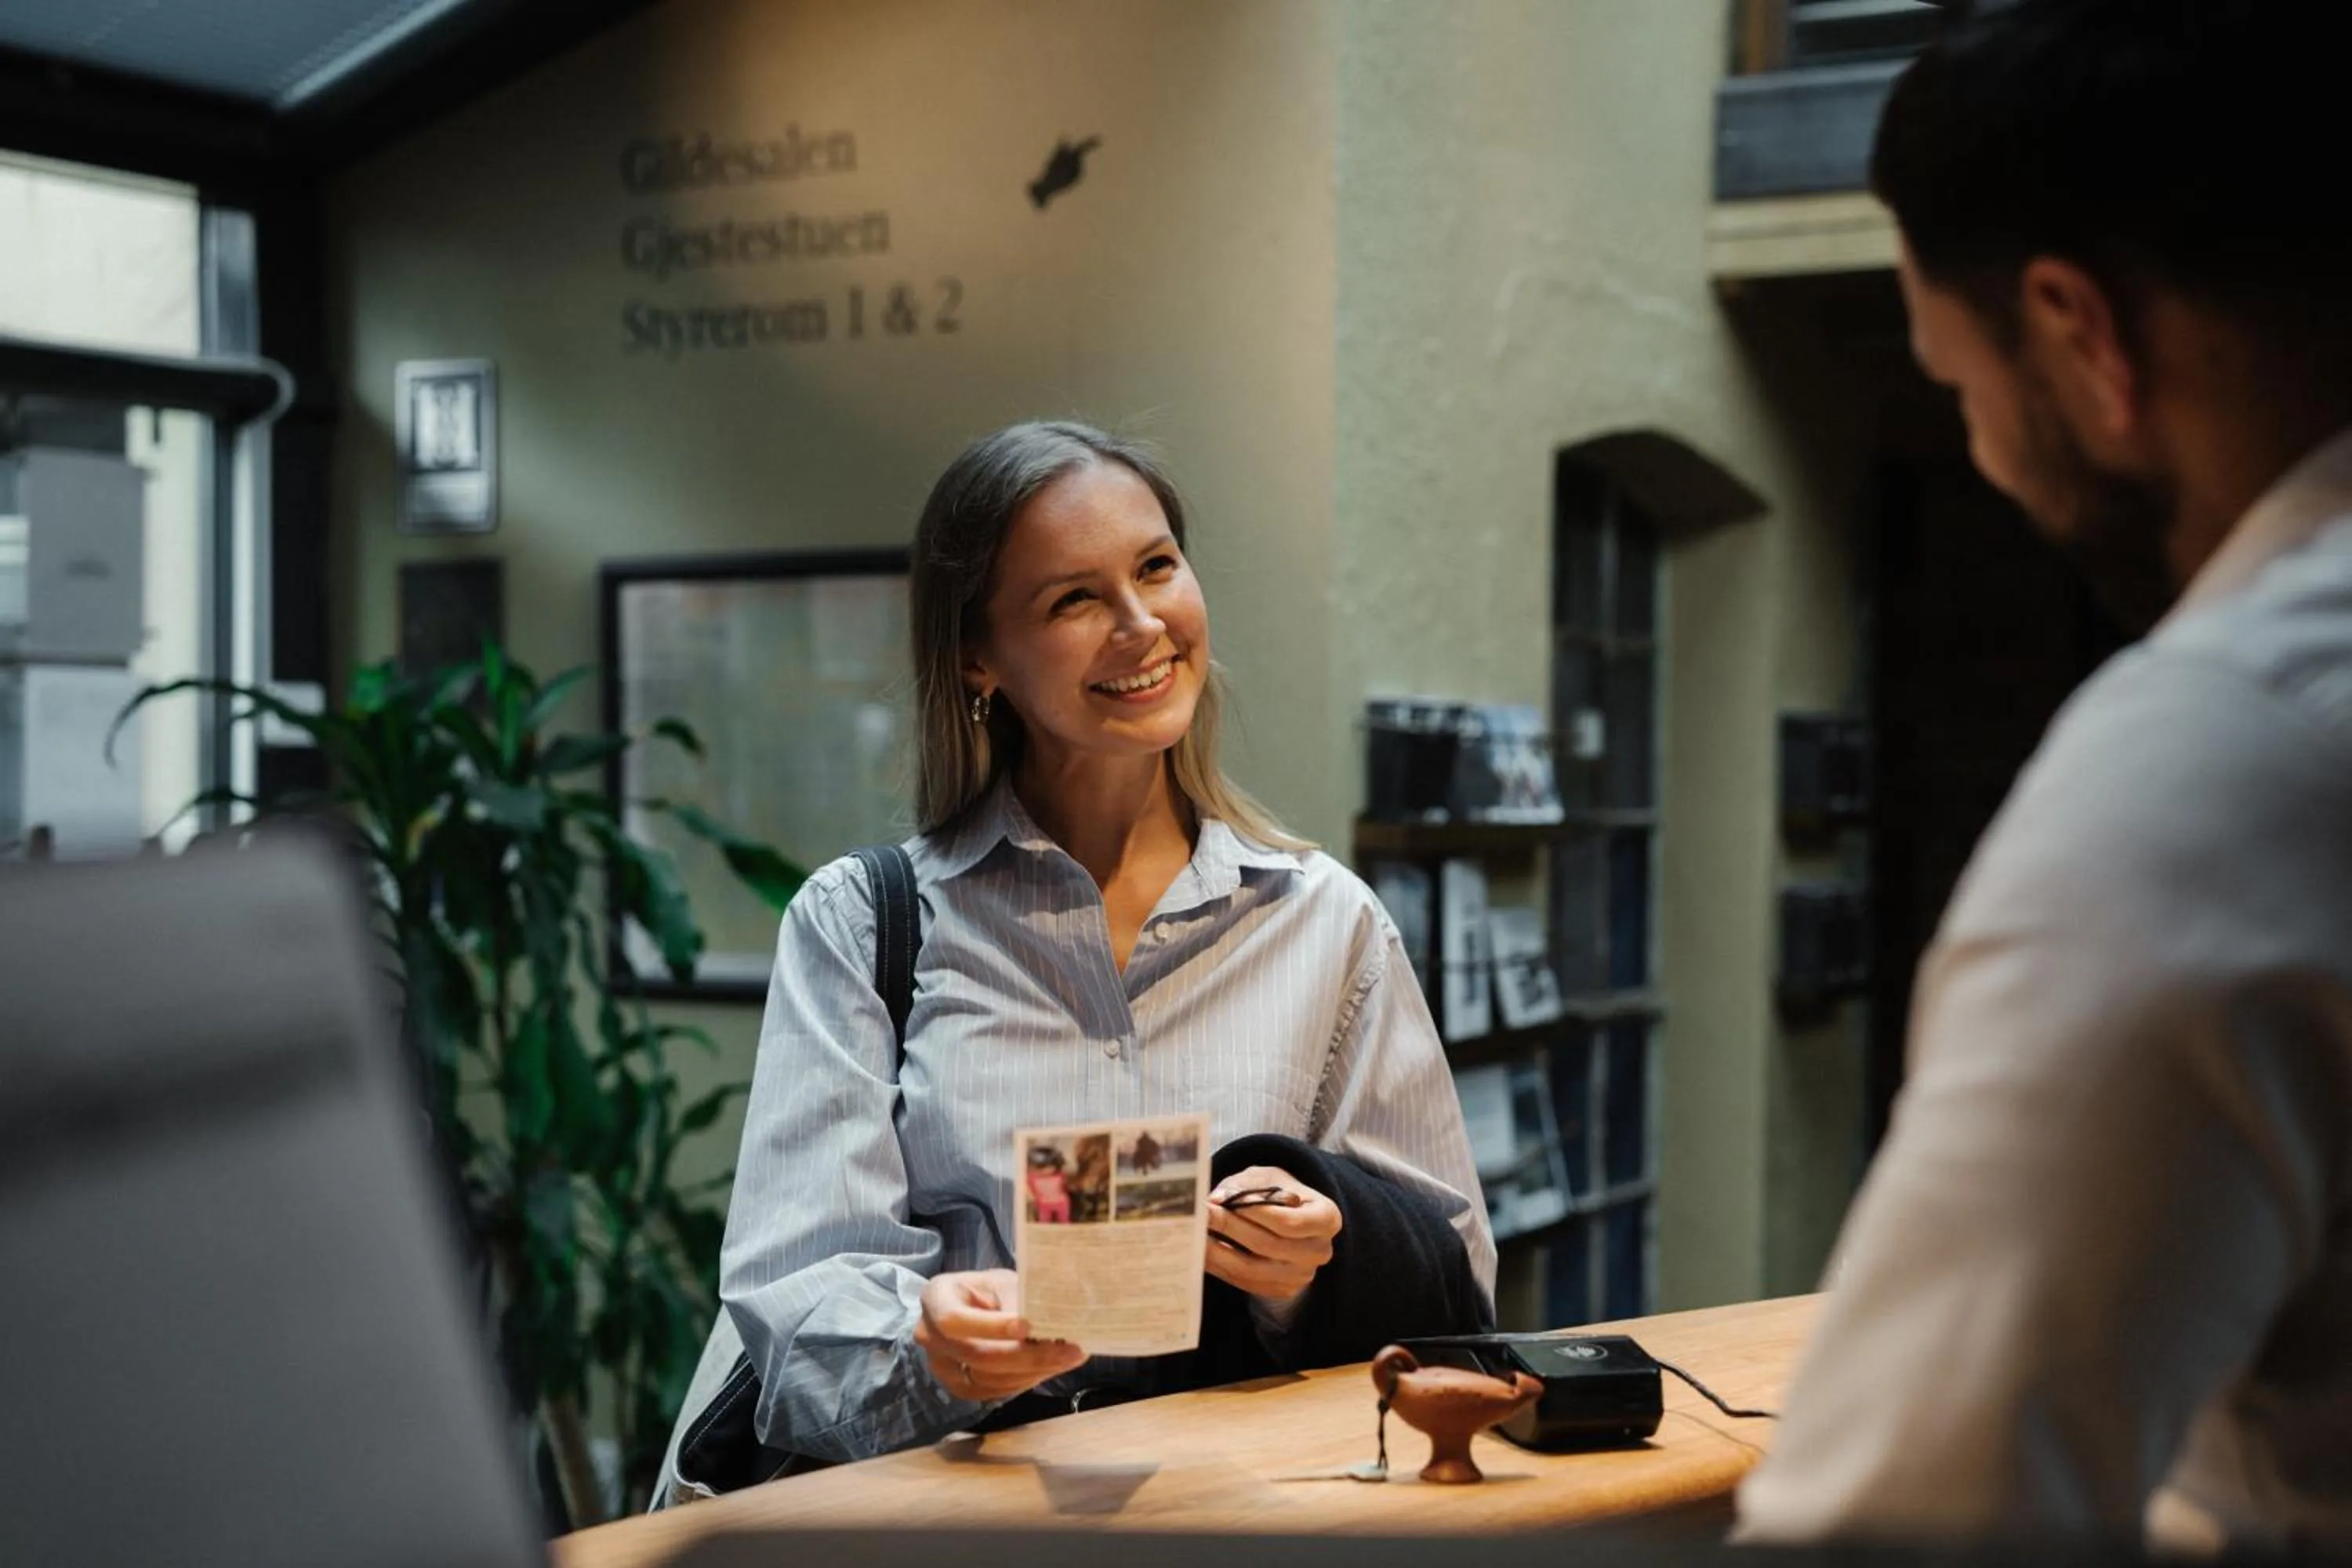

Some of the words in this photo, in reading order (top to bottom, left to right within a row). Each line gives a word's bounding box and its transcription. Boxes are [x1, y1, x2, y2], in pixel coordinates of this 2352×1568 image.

[619, 122, 858, 194] Gildesalen
[621, 209, 891, 282] Gjestestuen
[847, 285, 865, 339] 1
[880, 281, 920, 336] &
[934, 274, 964, 335] 2
